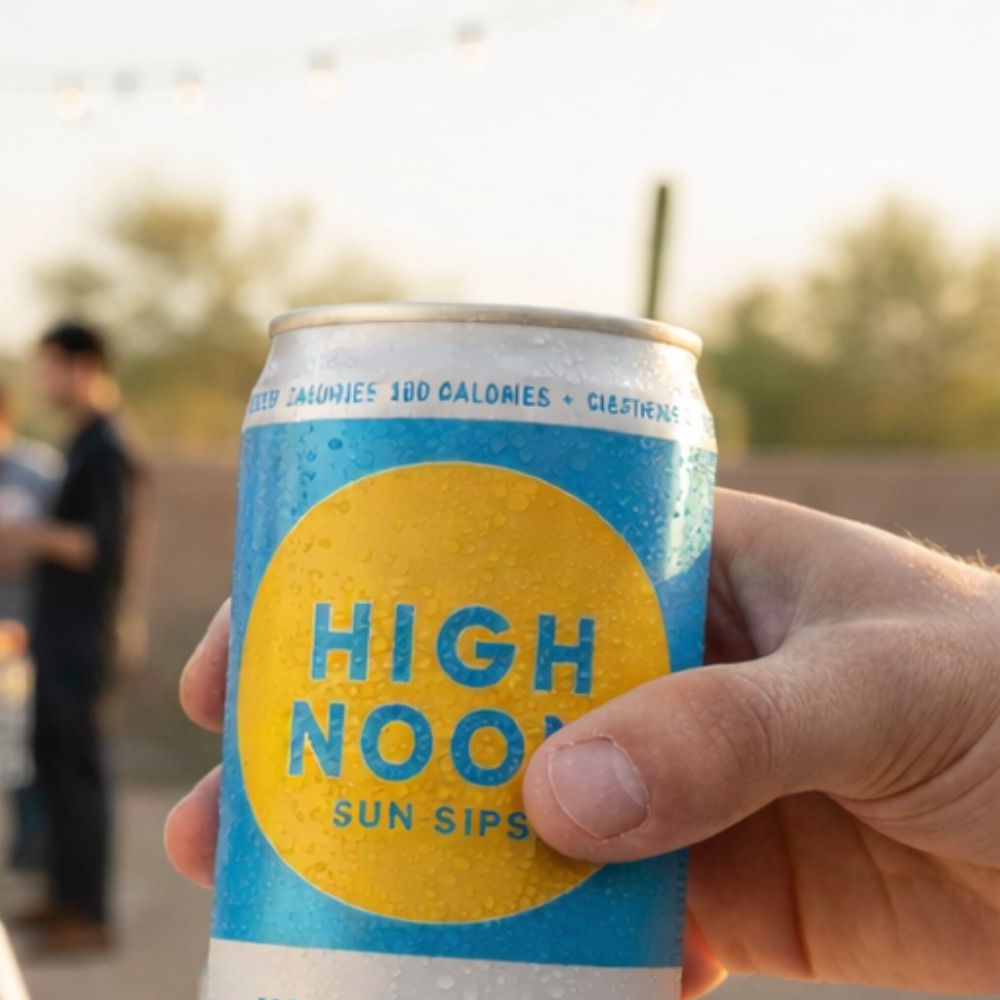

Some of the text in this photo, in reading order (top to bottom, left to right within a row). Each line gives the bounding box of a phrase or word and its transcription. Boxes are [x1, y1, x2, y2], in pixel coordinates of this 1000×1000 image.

[439, 381, 551, 407] CALORIES
[310, 600, 596, 696] HIGH
[287, 700, 568, 787] NOO
[332, 799, 529, 841] SUN SIPS
